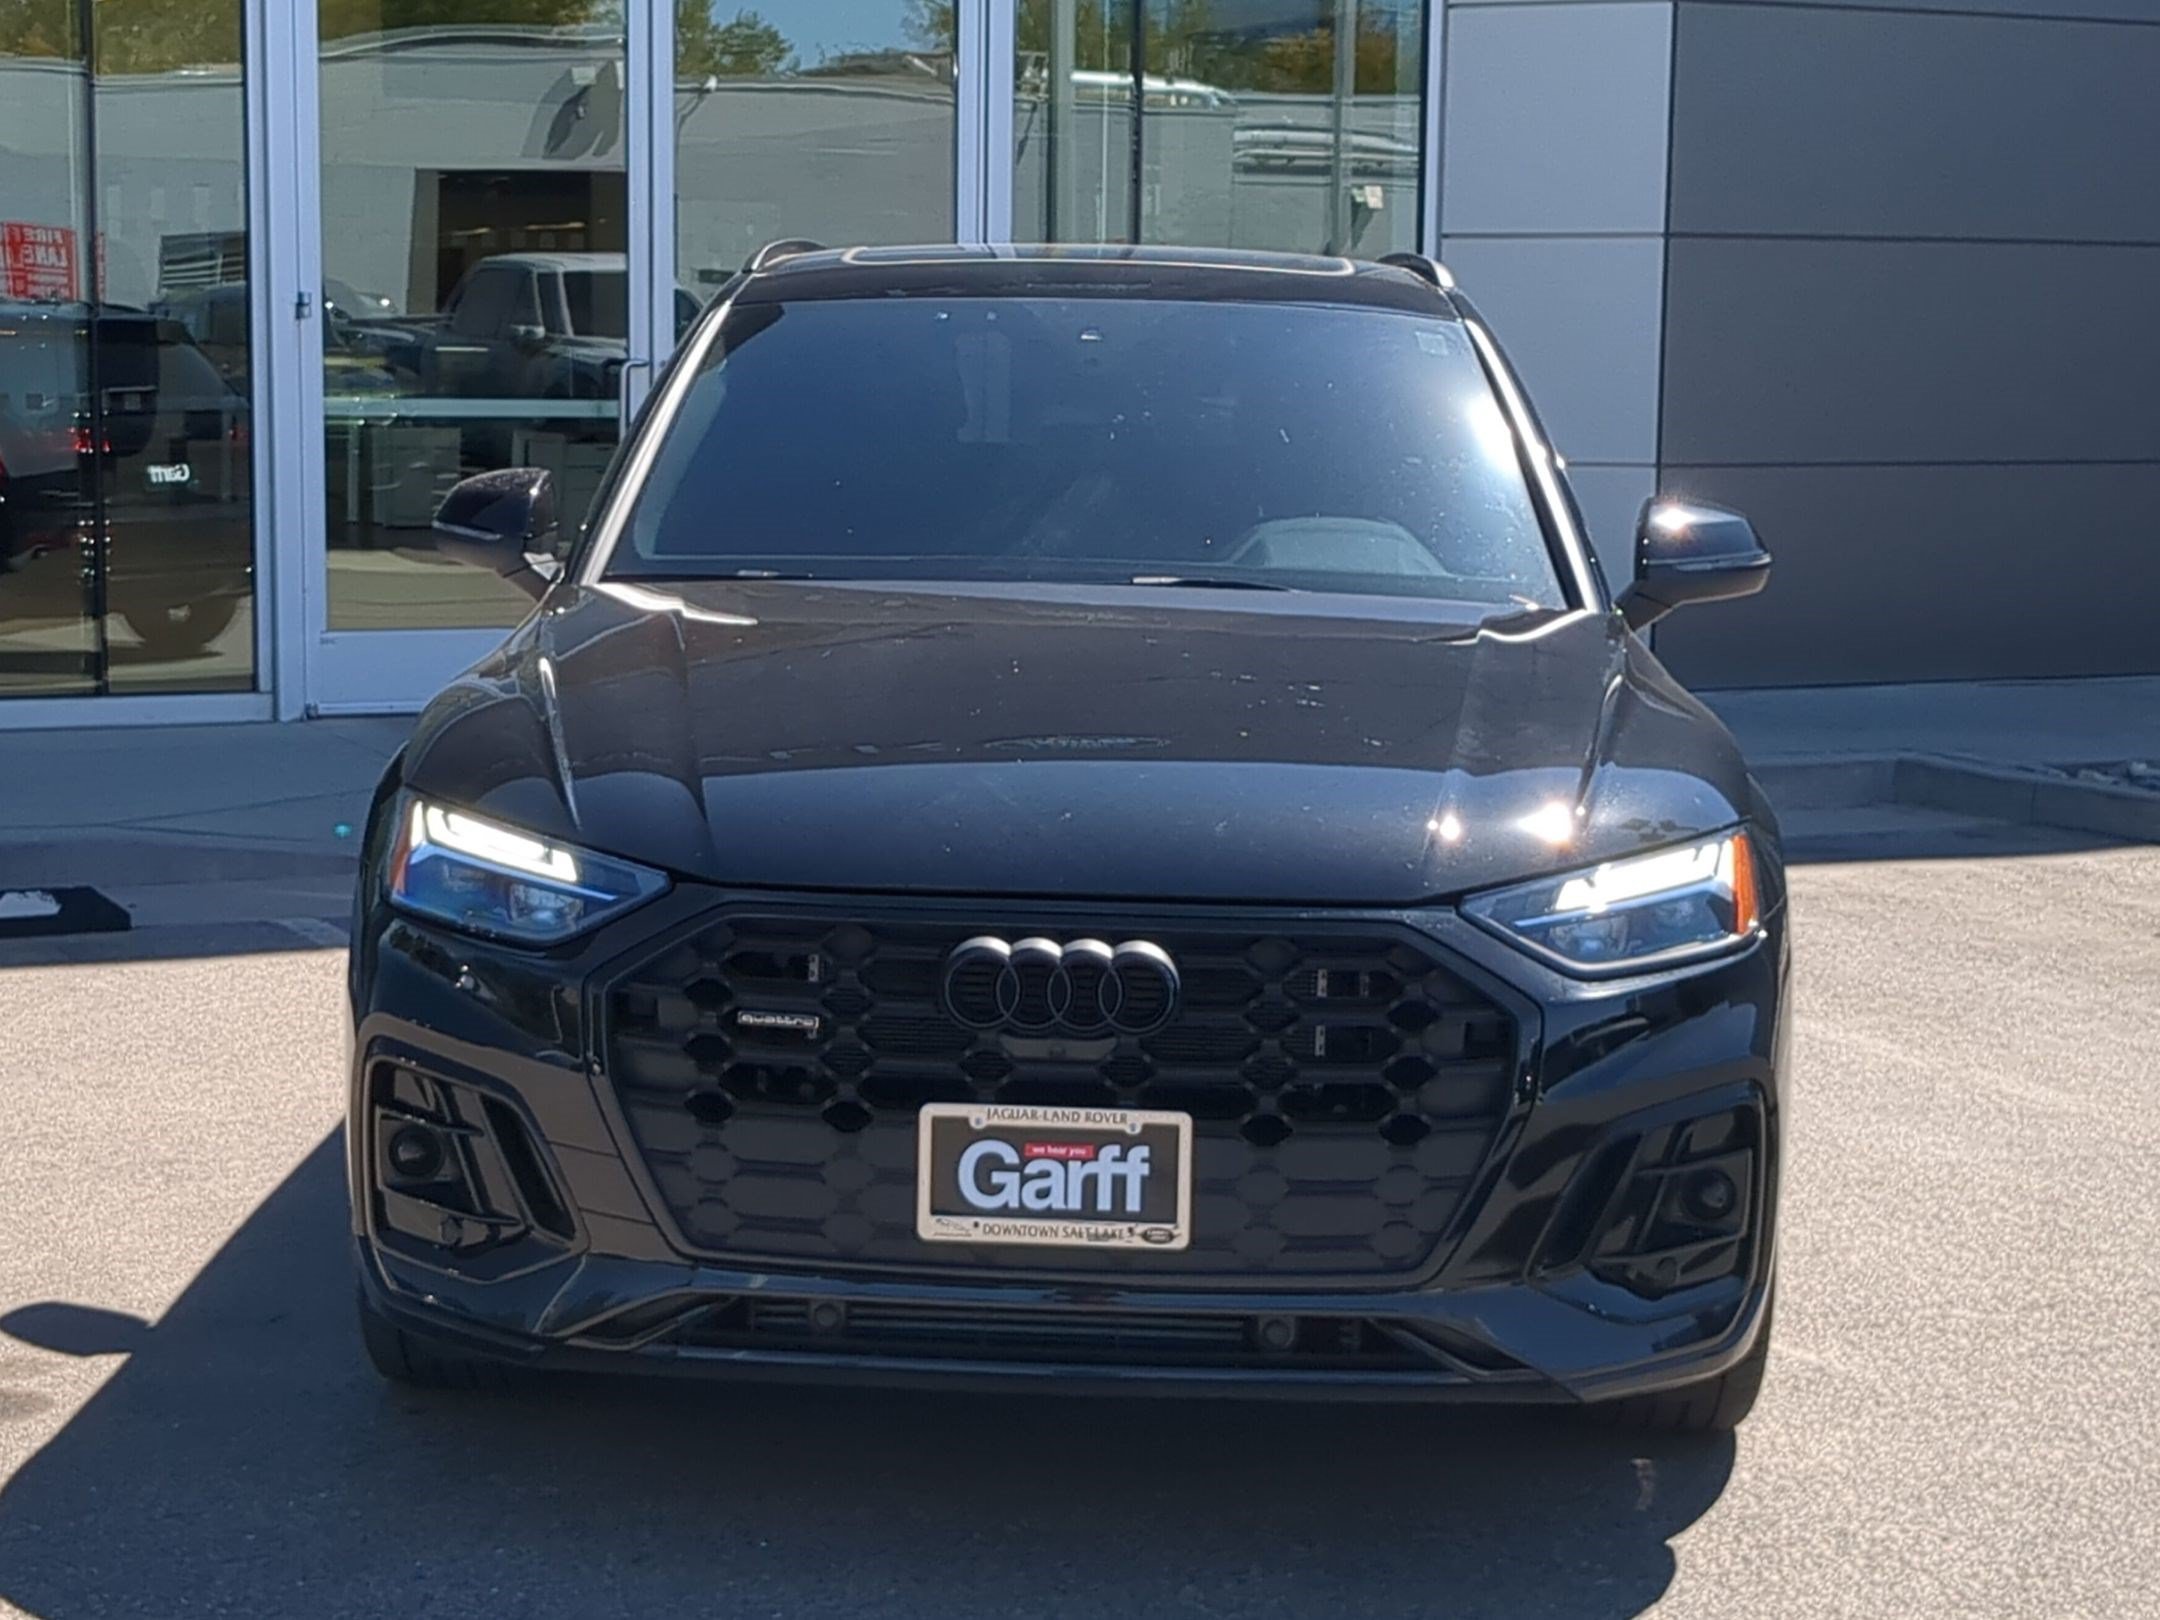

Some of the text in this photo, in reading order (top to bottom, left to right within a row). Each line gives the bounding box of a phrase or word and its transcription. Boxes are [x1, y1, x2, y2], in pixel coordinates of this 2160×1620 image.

[740, 1013, 816, 1027] quattro
[986, 1107, 1128, 1124] JAGUAR LAND ROVER
[1067, 1148, 1087, 1157] you
[958, 1139, 1150, 1212] Garff
[982, 1223, 1059, 1238] DOWNTOWN
